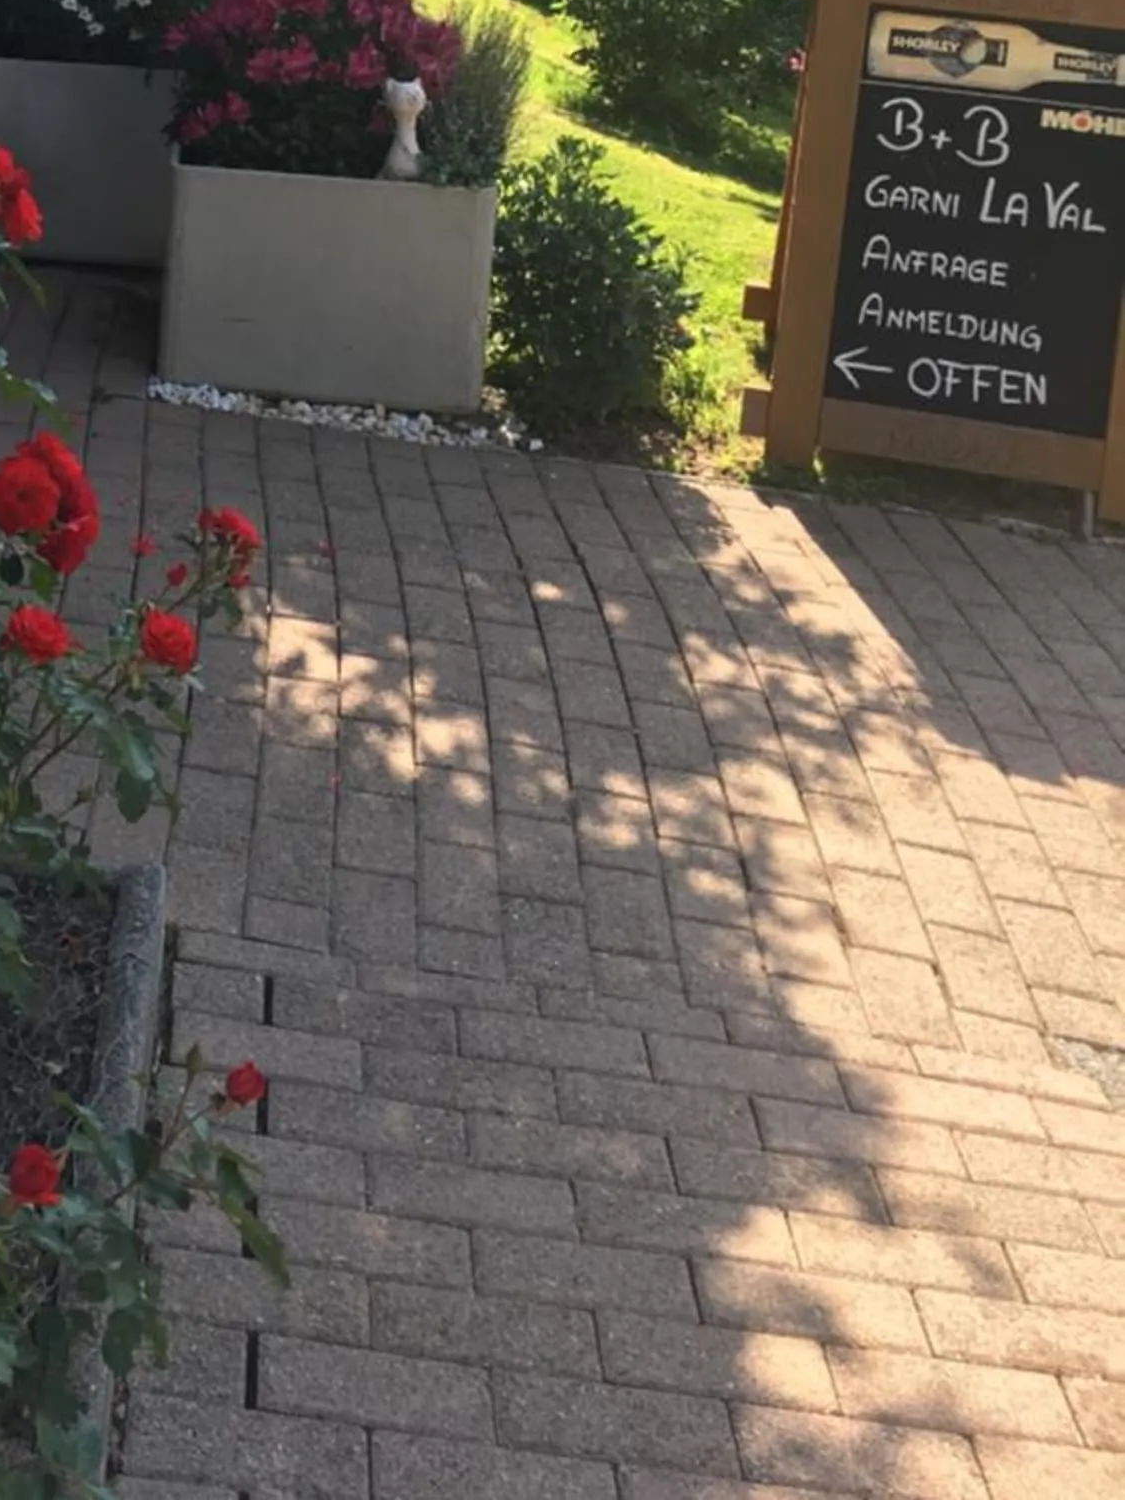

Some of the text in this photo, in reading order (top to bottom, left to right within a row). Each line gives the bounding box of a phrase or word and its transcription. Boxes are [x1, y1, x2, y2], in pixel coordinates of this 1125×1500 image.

[865, 174, 1107, 233] GARNI LA VAL
[861, 233, 1009, 287] ANFRAGE
[858, 292, 1043, 353] ANMELDUNG
[907, 357, 1048, 405] OFFEN
